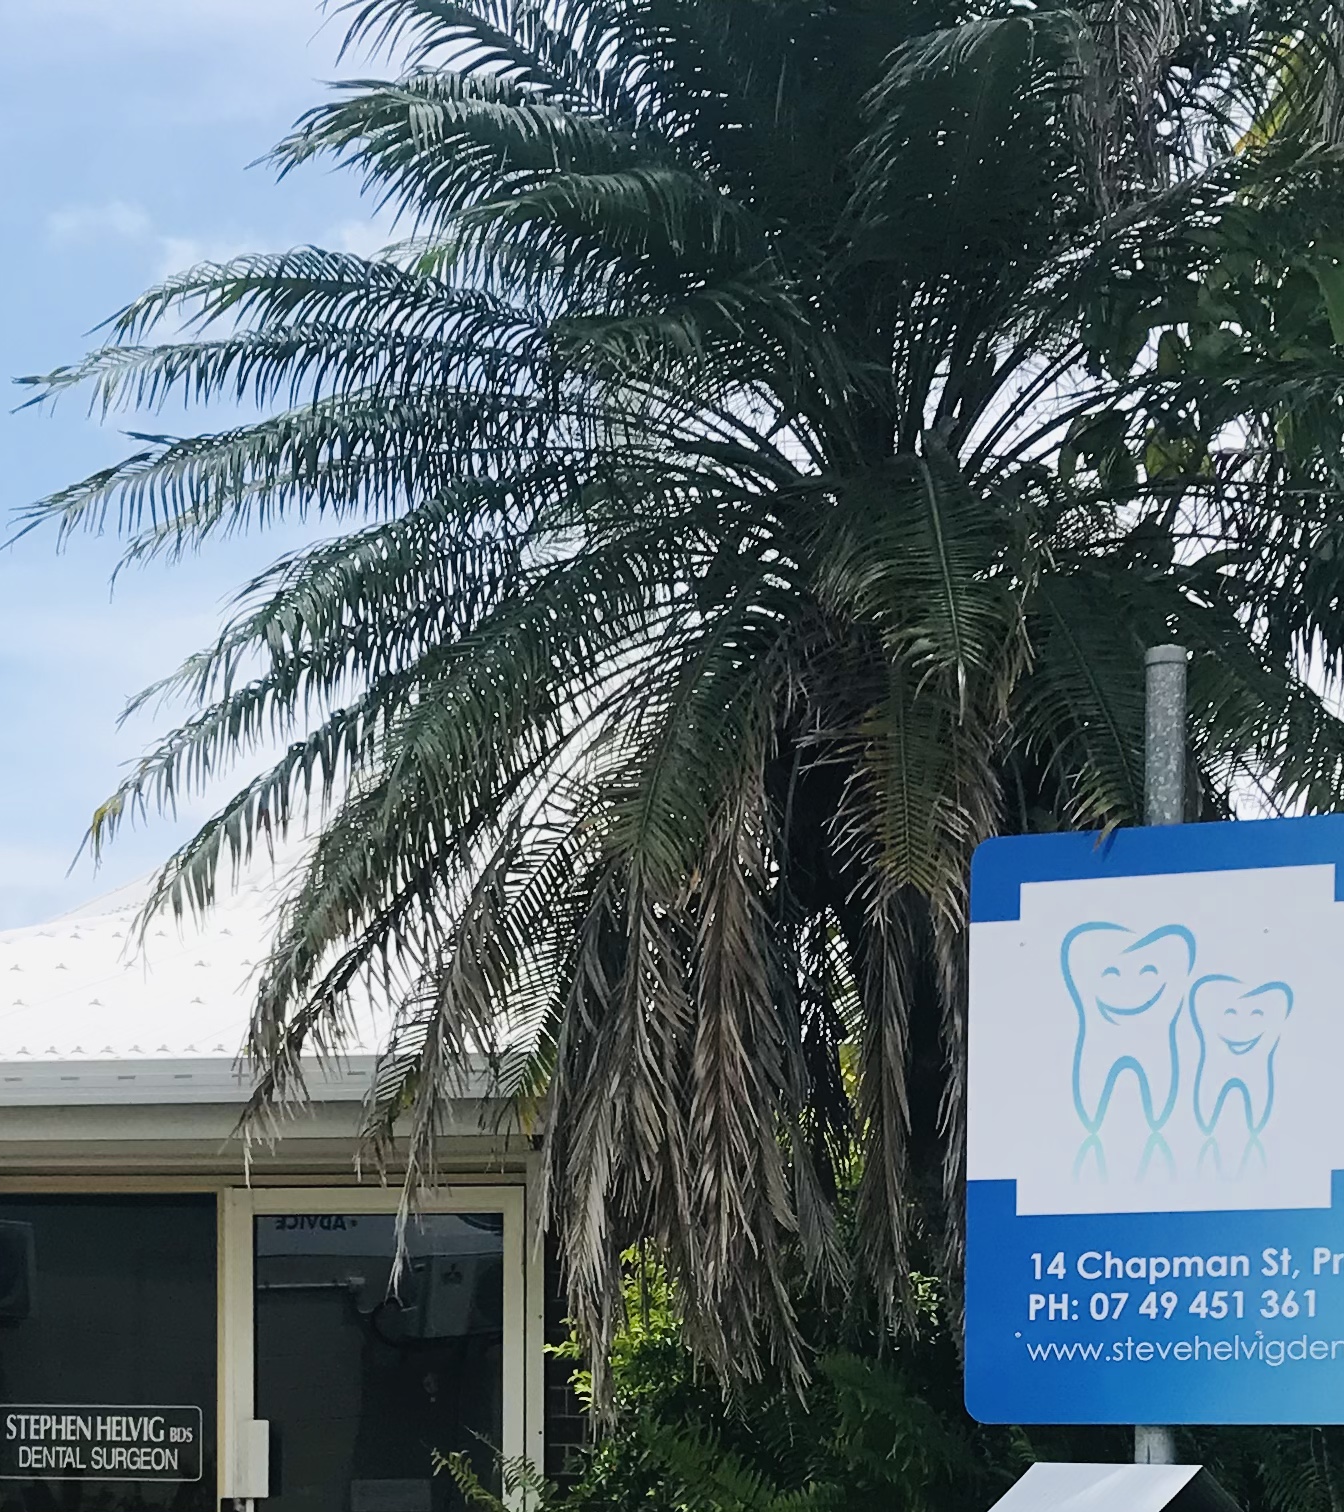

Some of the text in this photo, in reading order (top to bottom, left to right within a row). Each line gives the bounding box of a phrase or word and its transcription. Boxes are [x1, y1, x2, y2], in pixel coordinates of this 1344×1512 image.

[1029, 1252, 1067, 1281] 14
[1076, 1250, 1251, 1286] Chapman
[1260, 1247, 1301, 1282] St,
[1028, 1289, 1318, 1322] PH: 07 49 451 361
[6, 1414, 194, 1443] STEPHEN HELVIG BDS
[18, 1446, 179, 1471] DENTAL SURGEON
